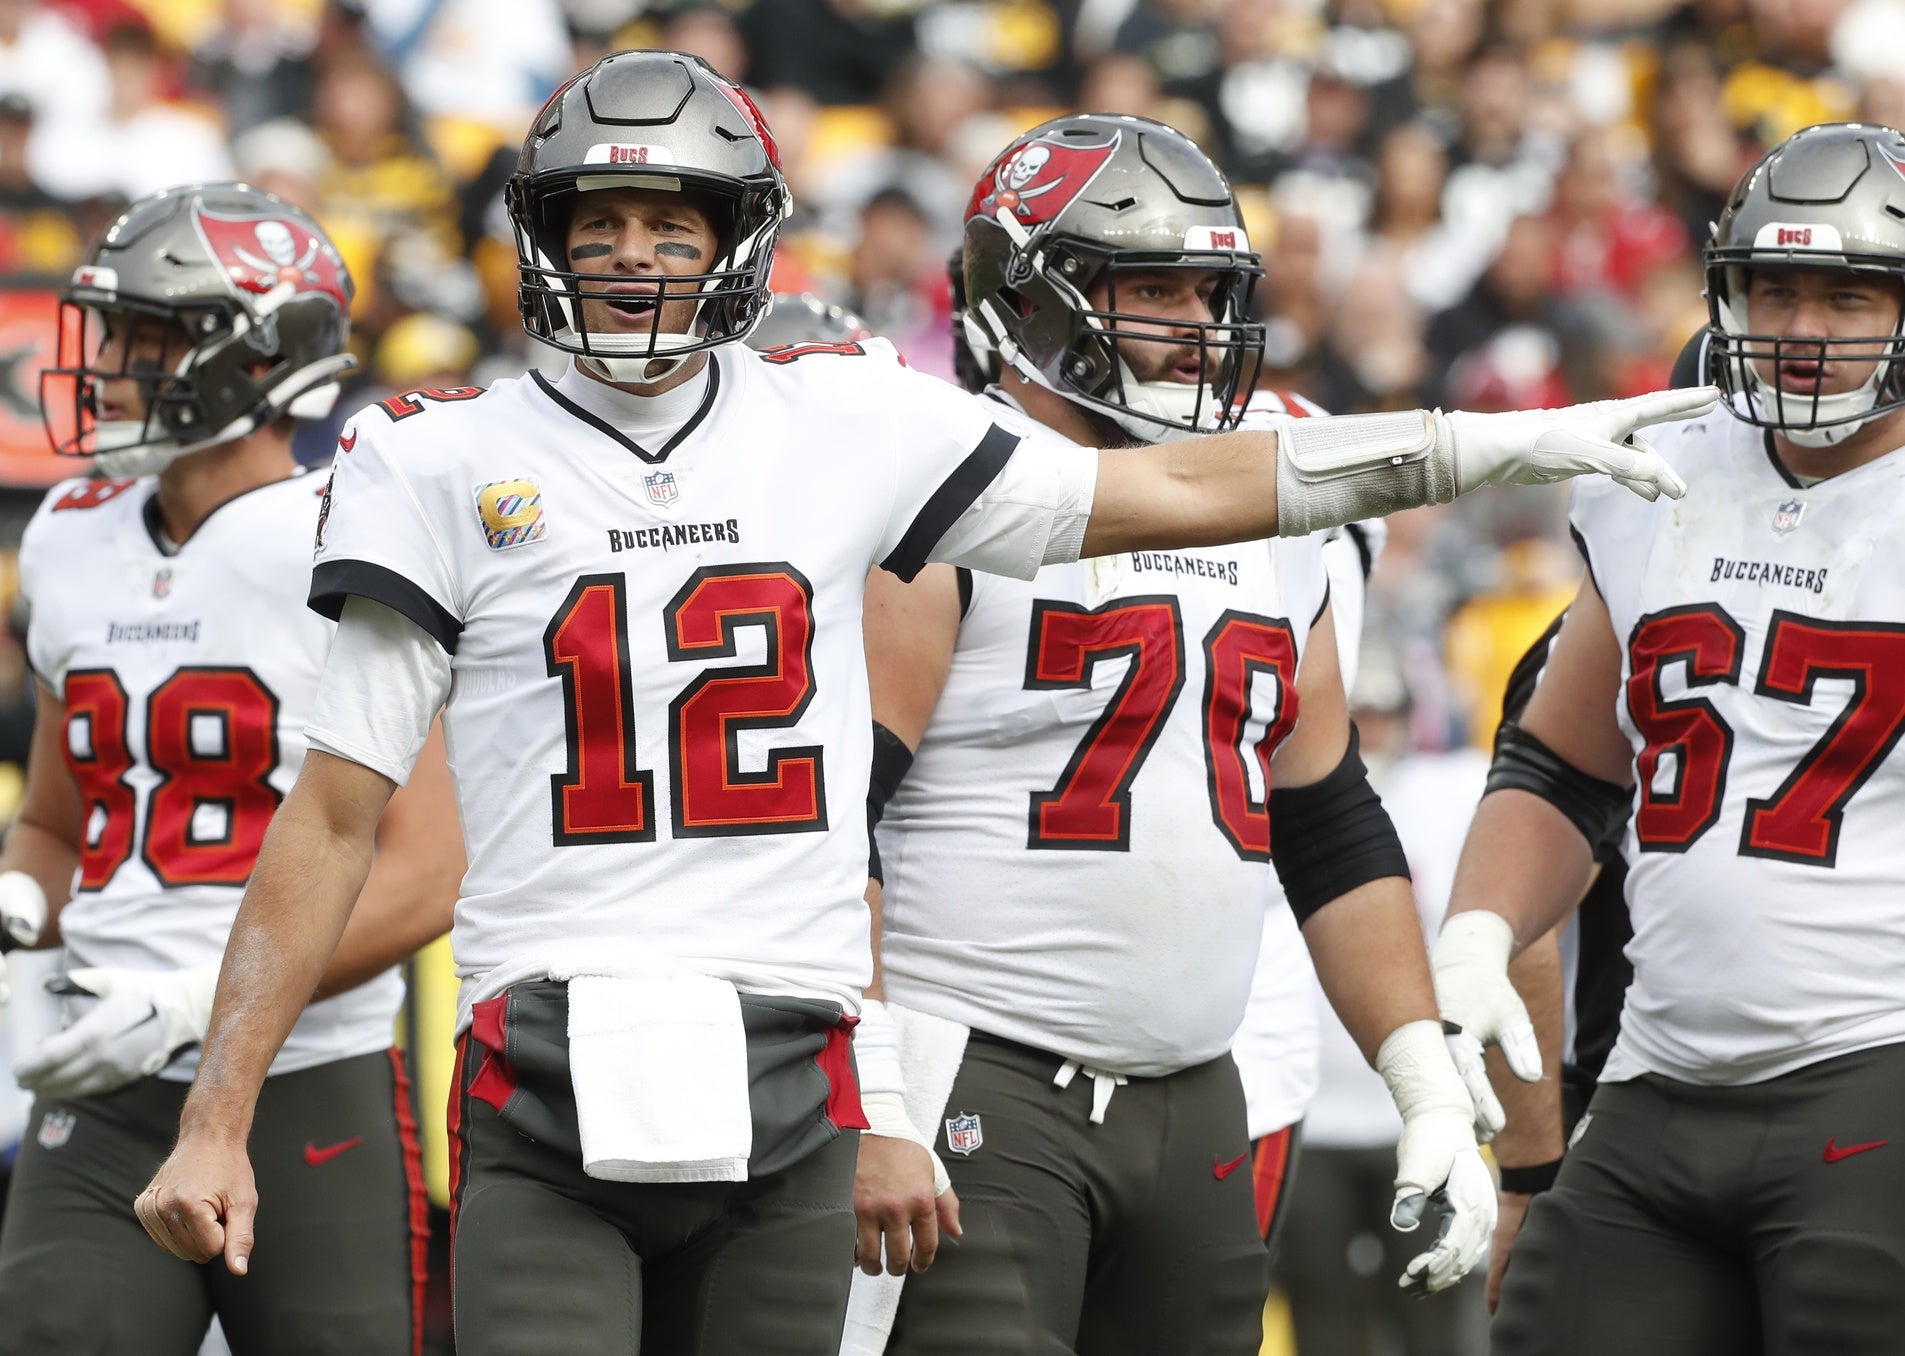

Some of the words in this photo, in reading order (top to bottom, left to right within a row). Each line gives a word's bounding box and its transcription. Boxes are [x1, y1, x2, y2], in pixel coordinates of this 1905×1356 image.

[609, 146, 648, 164] BUCS
[480, 481, 539, 531] C
[651, 484, 676, 500] NFL
[607, 519, 739, 553] BUCCANEERS
[1132, 551, 1238, 586] BUCCANEERS
[1710, 557, 1828, 594] BUCCANEERS
[543, 561, 829, 847] 12
[1022, 594, 1299, 864] 70
[1627, 602, 1905, 868] 67
[60, 666, 285, 892] 88
[953, 1131, 977, 1147] NFL
